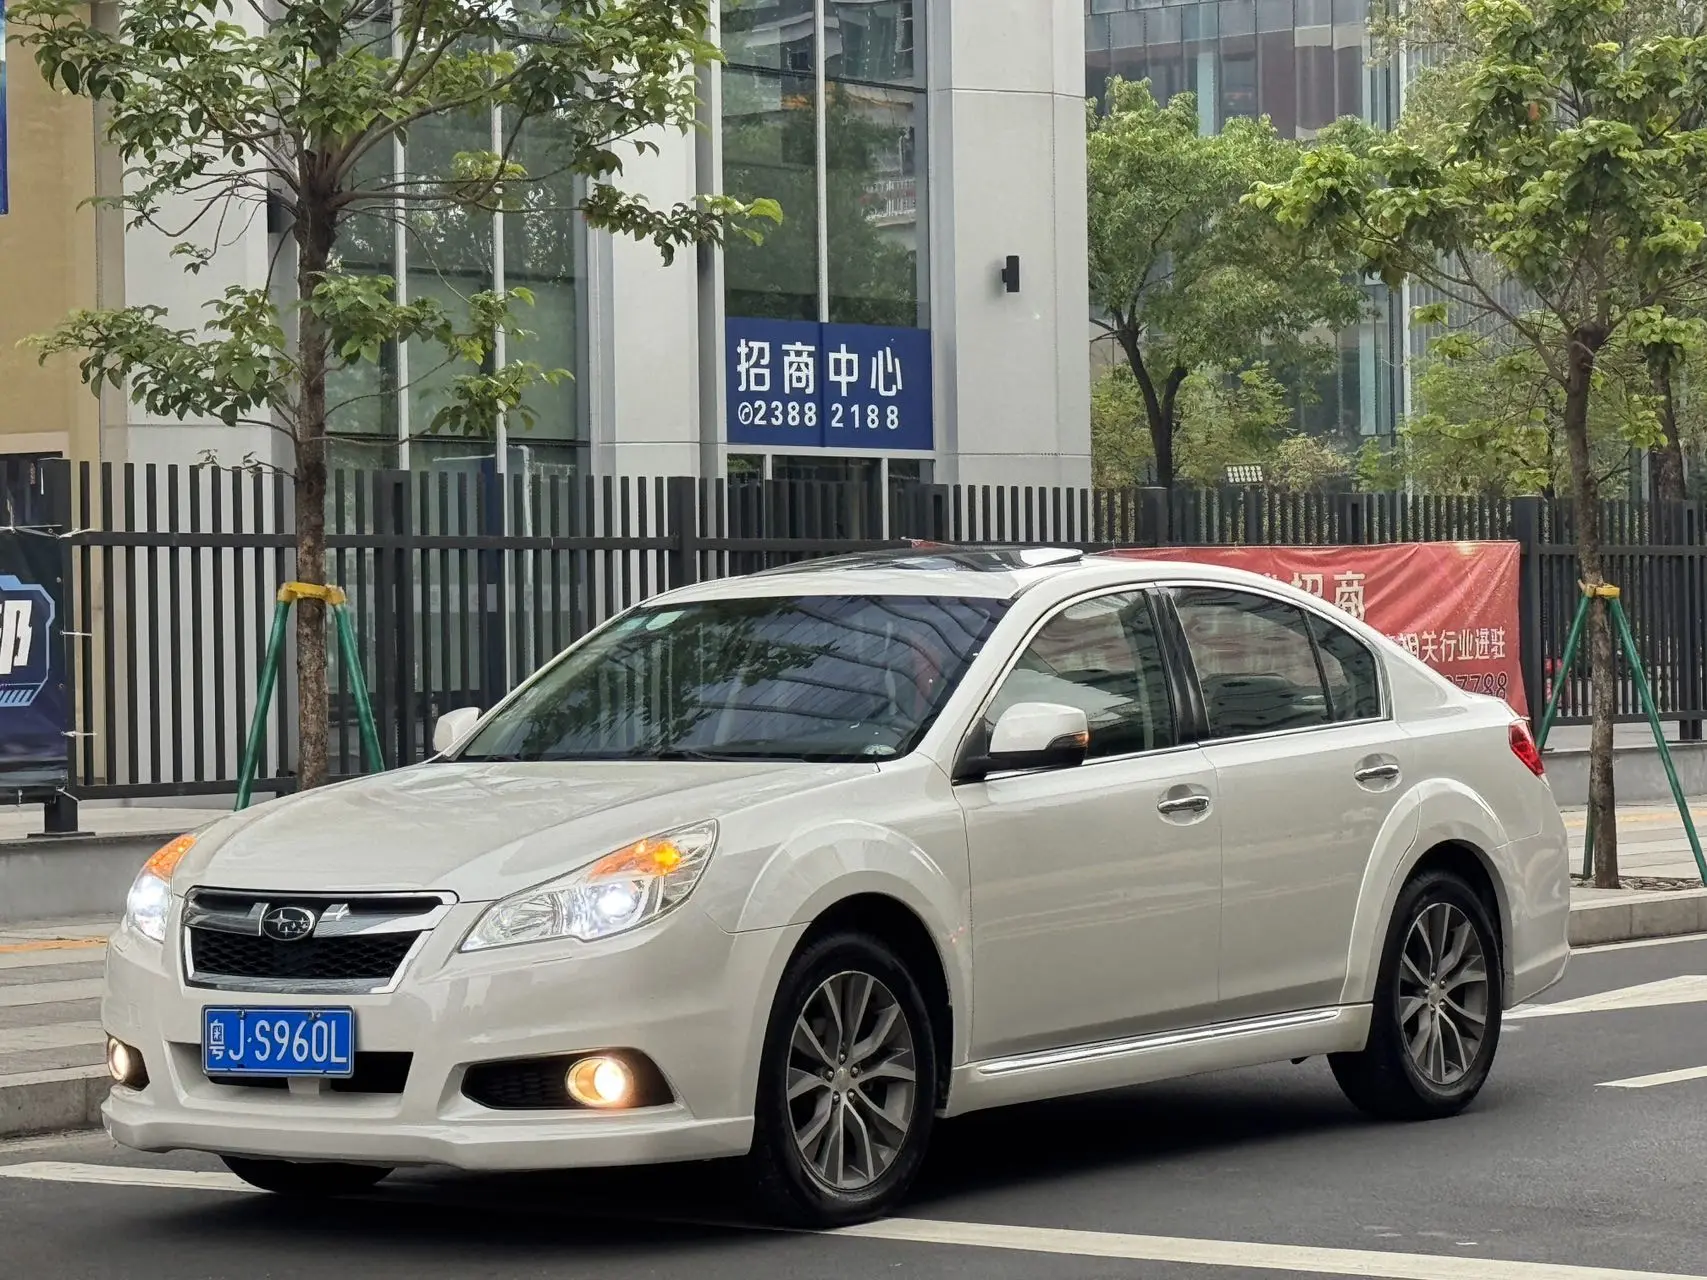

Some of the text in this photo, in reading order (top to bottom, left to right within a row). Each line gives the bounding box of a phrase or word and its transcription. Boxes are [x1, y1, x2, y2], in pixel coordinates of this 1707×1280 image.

[737, 338, 903, 397] 招商中心
[753, 400, 899, 430] 2388 2188
[1386, 626, 1506, 662] 相关行业进驻
[1444, 671, 1509, 699] 7788
